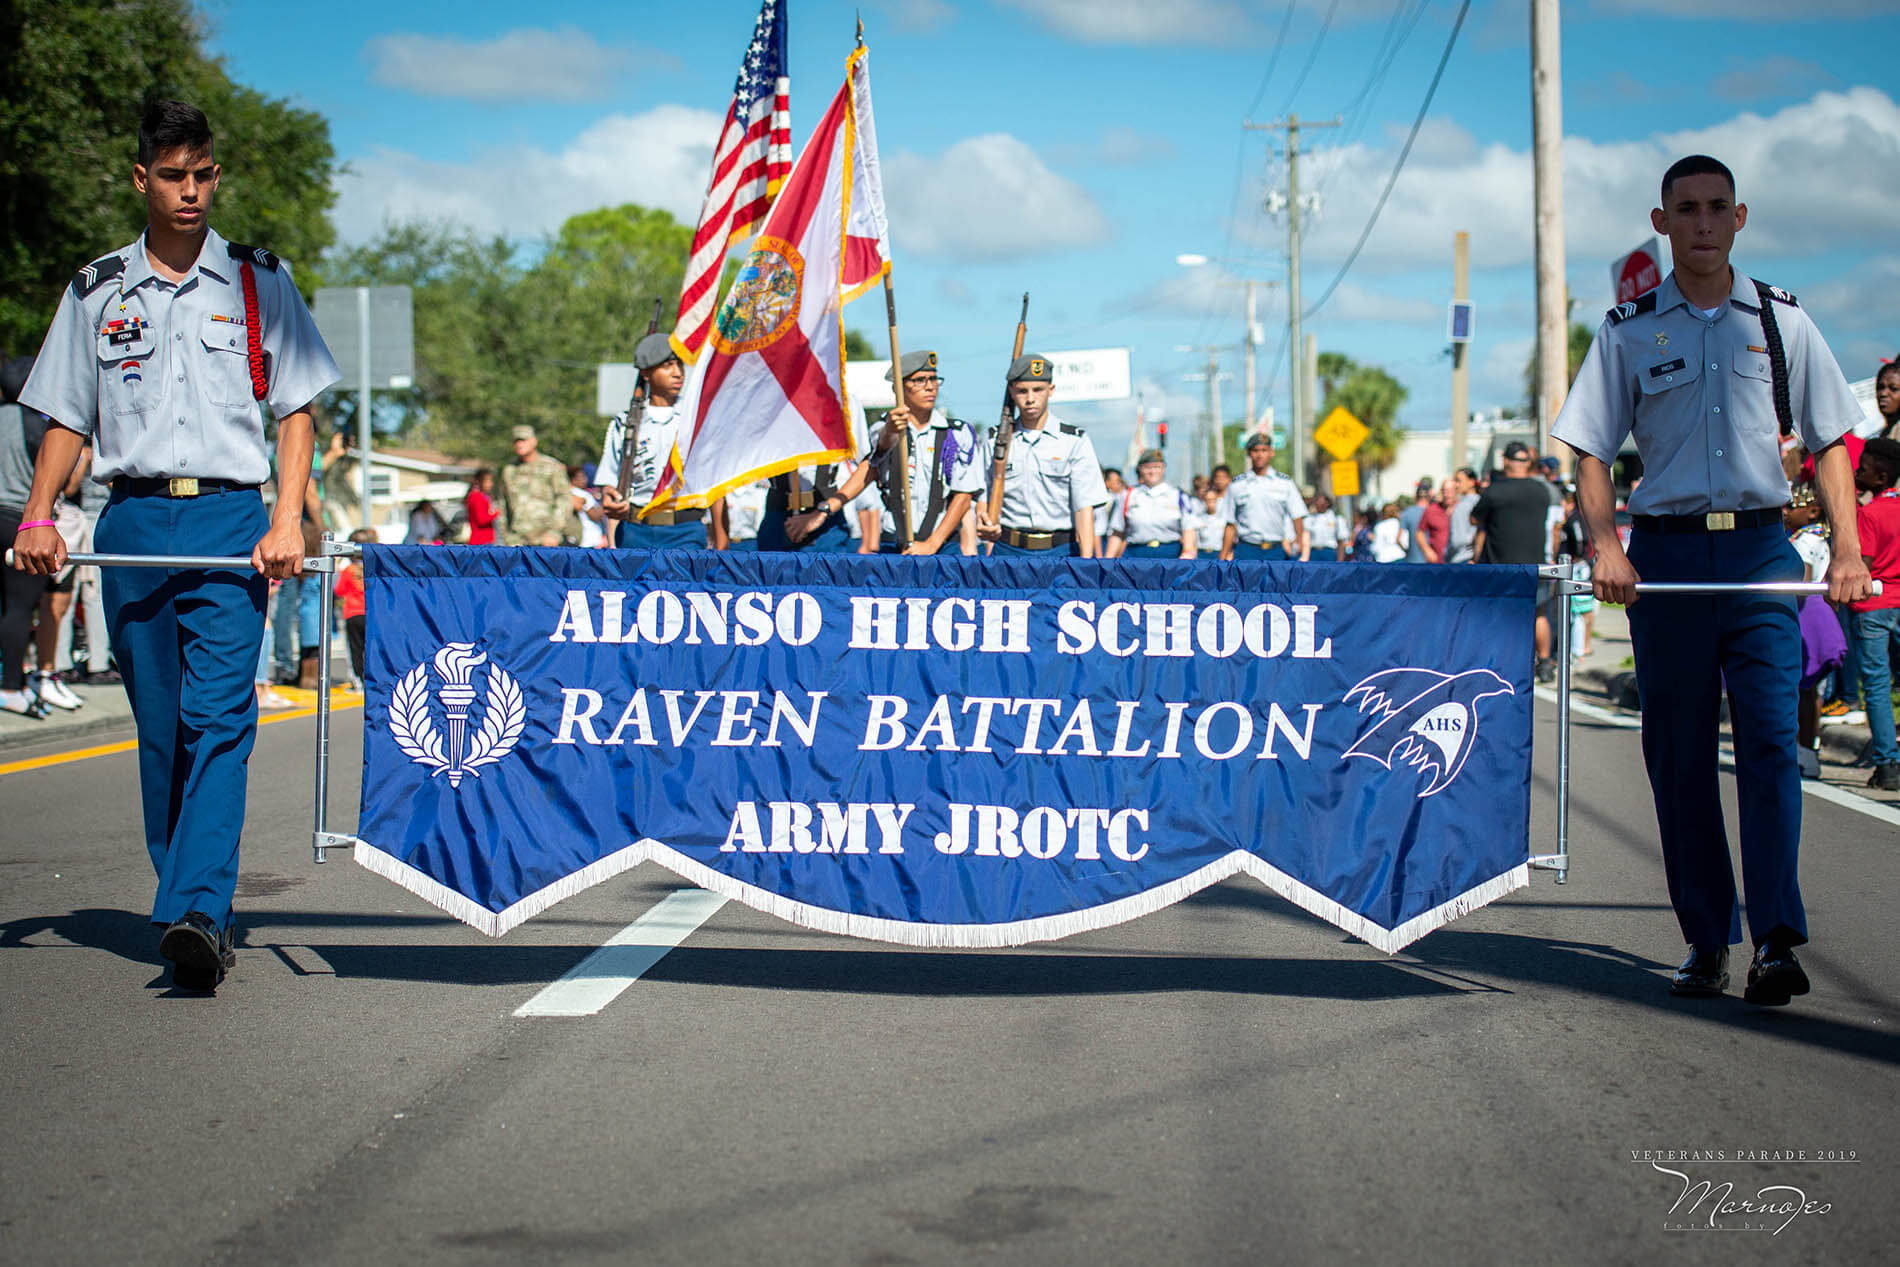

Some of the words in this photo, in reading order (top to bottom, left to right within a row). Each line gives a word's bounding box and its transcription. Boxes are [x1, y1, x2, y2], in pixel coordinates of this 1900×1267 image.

[1621, 277, 1636, 302] DO
[1635, 263, 1656, 291] NOT
[549, 589, 823, 647] ALONSO
[848, 596, 1033, 653] HIGH
[1056, 599, 1332, 660] SCHOOL
[551, 687, 829, 748] RAVEN
[857, 693, 1324, 761] BATTALION
[1423, 717, 1462, 732] AHS
[719, 801, 916, 855] ARMY
[933, 802, 1150, 863] JROTC
